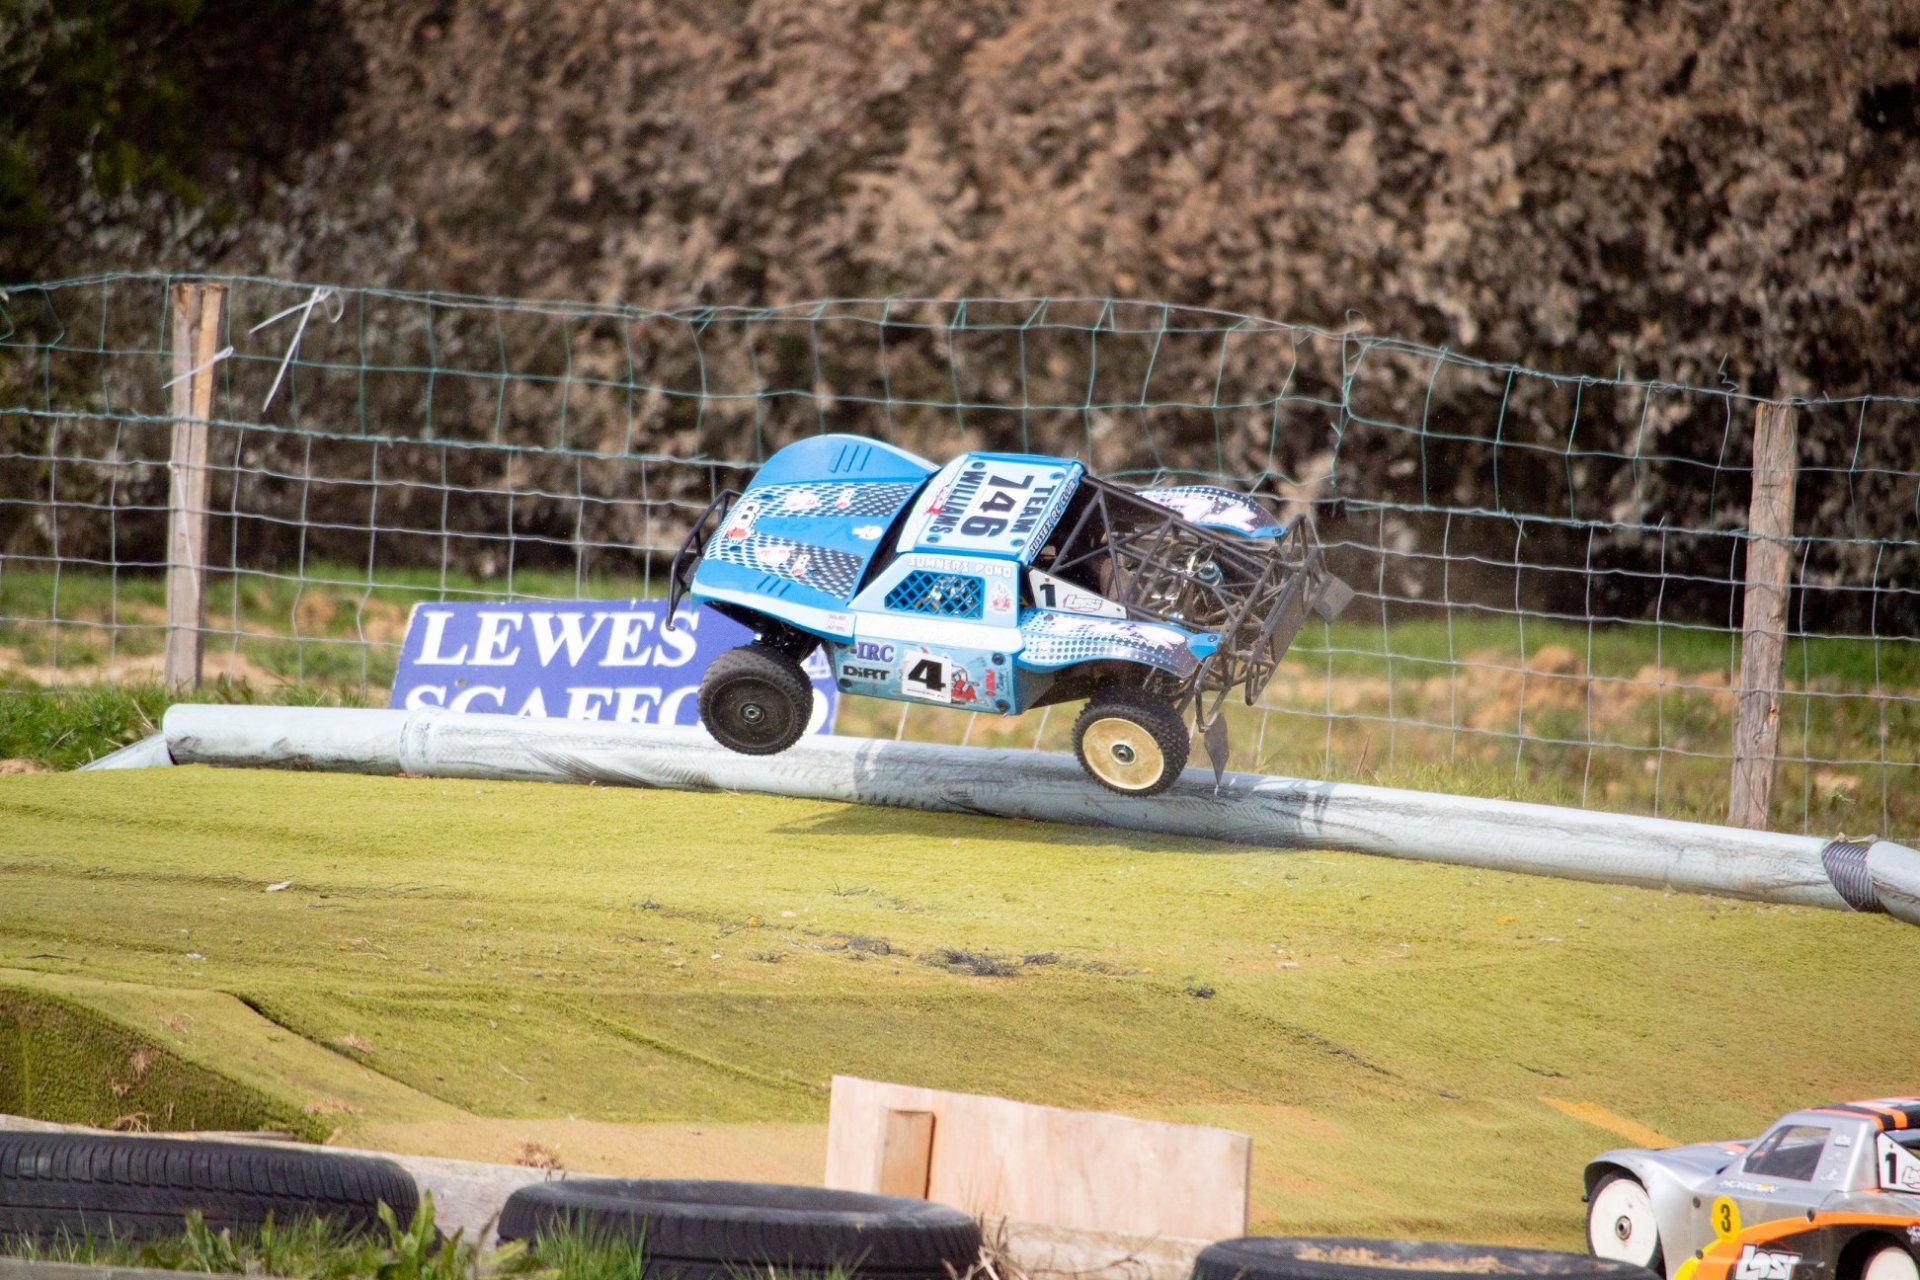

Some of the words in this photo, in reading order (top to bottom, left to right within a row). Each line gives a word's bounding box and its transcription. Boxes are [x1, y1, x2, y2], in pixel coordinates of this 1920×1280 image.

[960, 475, 1034, 537] 746
[1010, 485, 1056, 533] TEAM
[1039, 583, 1056, 608] 1
[413, 611, 700, 668] LEWES
[856, 641, 895, 663] IRC
[908, 659, 946, 692] 4
[1885, 1152, 1897, 1184] 1
[1720, 1203, 1731, 1233] 3
